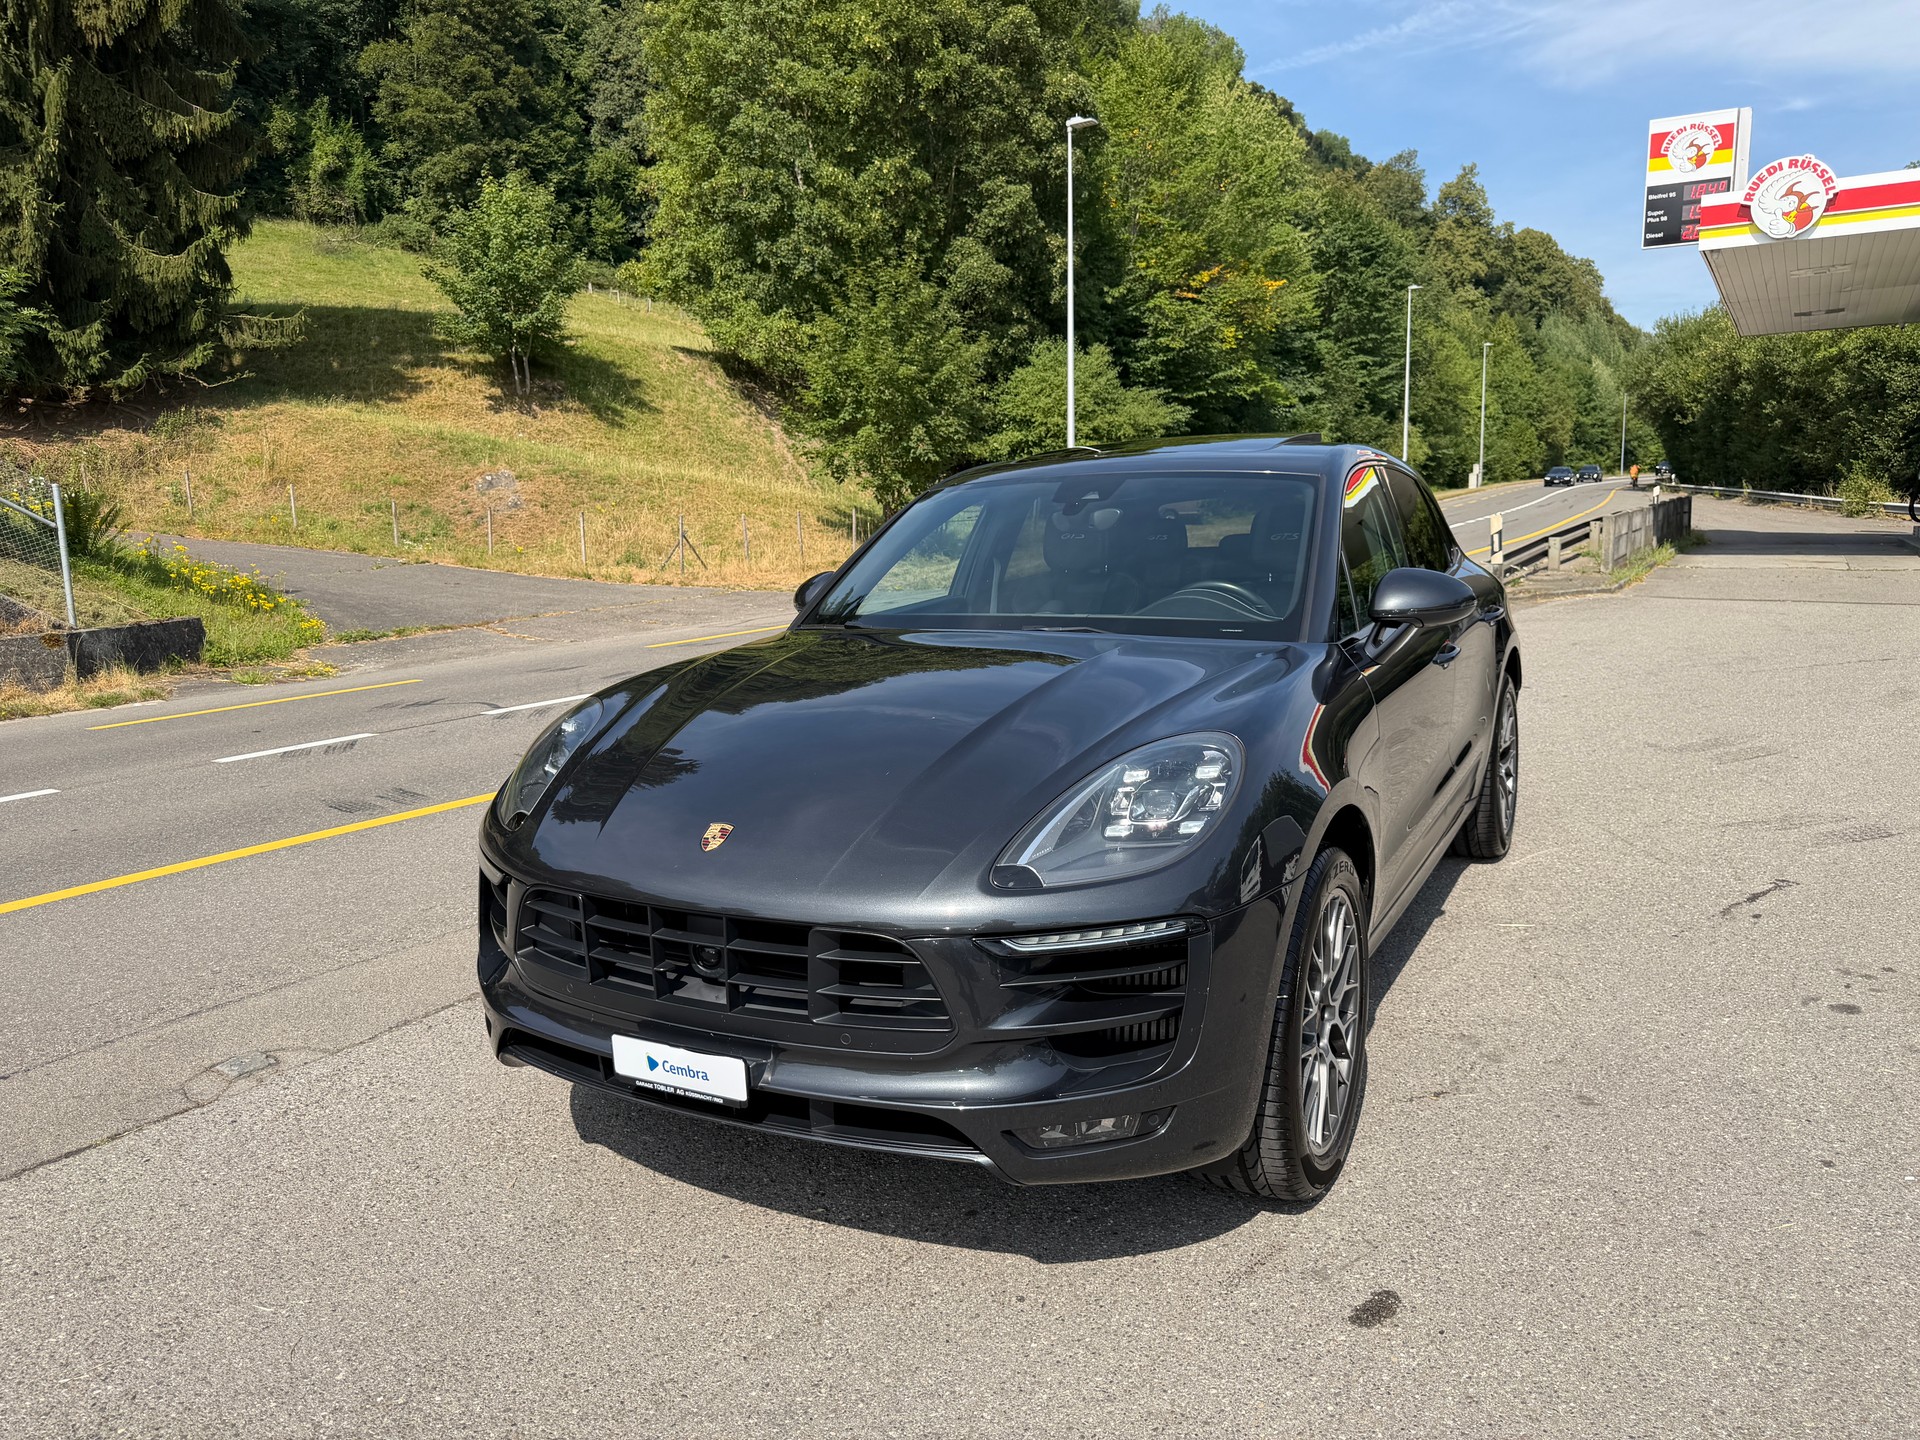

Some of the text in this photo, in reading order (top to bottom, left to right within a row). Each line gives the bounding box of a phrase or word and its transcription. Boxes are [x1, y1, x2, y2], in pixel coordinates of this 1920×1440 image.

[1662, 121, 1721, 152] RUEDI RÜSSEL
[1743, 155, 1836, 202] RUEDI RÜSSEL
[1270, 532, 1300, 540] GTS
[1333, 860, 1355, 879] ZERO
[661, 1059, 710, 1082] Cembra
[635, 1080, 653, 1089] GARAGE
[653, 1083, 675, 1094] TOBLER
